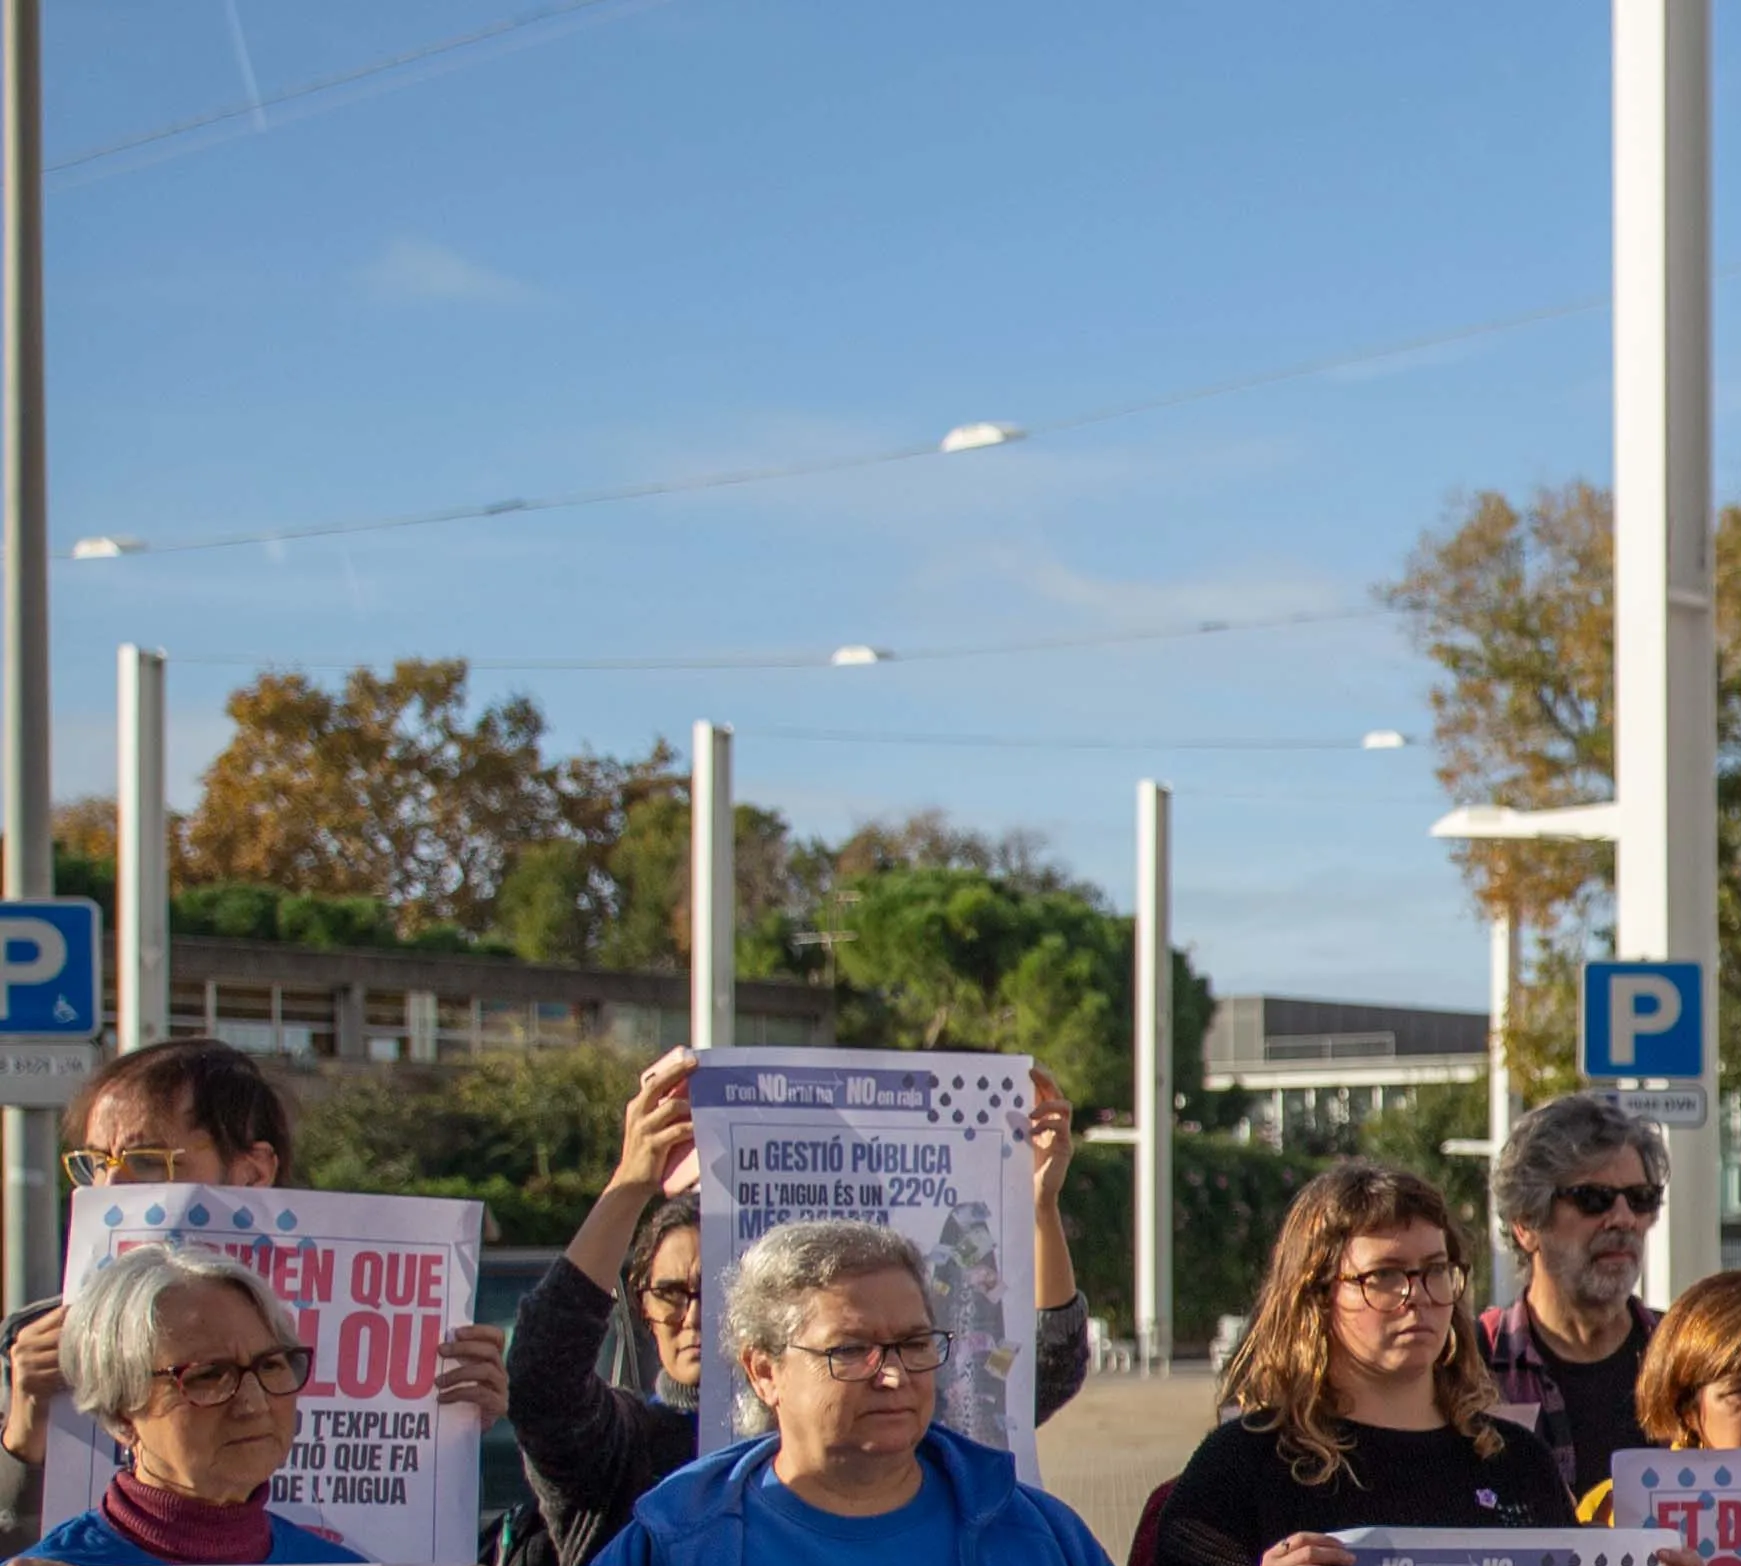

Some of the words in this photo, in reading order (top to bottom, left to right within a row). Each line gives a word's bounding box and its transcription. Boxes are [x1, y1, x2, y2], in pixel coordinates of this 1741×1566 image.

[0, 917, 67, 1020] P
[1609, 974, 1682, 1065] P
[738, 1149, 760, 1171] LA
[765, 1137, 844, 1173] GESTIÓ
[851, 1137, 952, 1174] PÚBLICA
[738, 1183, 762, 1205] DE
[766, 1183, 828, 1206] L'AIGUA
[833, 1180, 854, 1206] ÉS
[860, 1185, 882, 1206] UN
[889, 1177, 958, 1208] 22%
[351, 1251, 443, 1309] QUE
[311, 1410, 430, 1439] T'EXPLICA
[334, 1444, 381, 1472] QUE
[390, 1443, 418, 1472] FA
[272, 1476, 302, 1502] DE
[311, 1476, 406, 1504] L'AIGUA
[1658, 1502, 1700, 1551] ET
